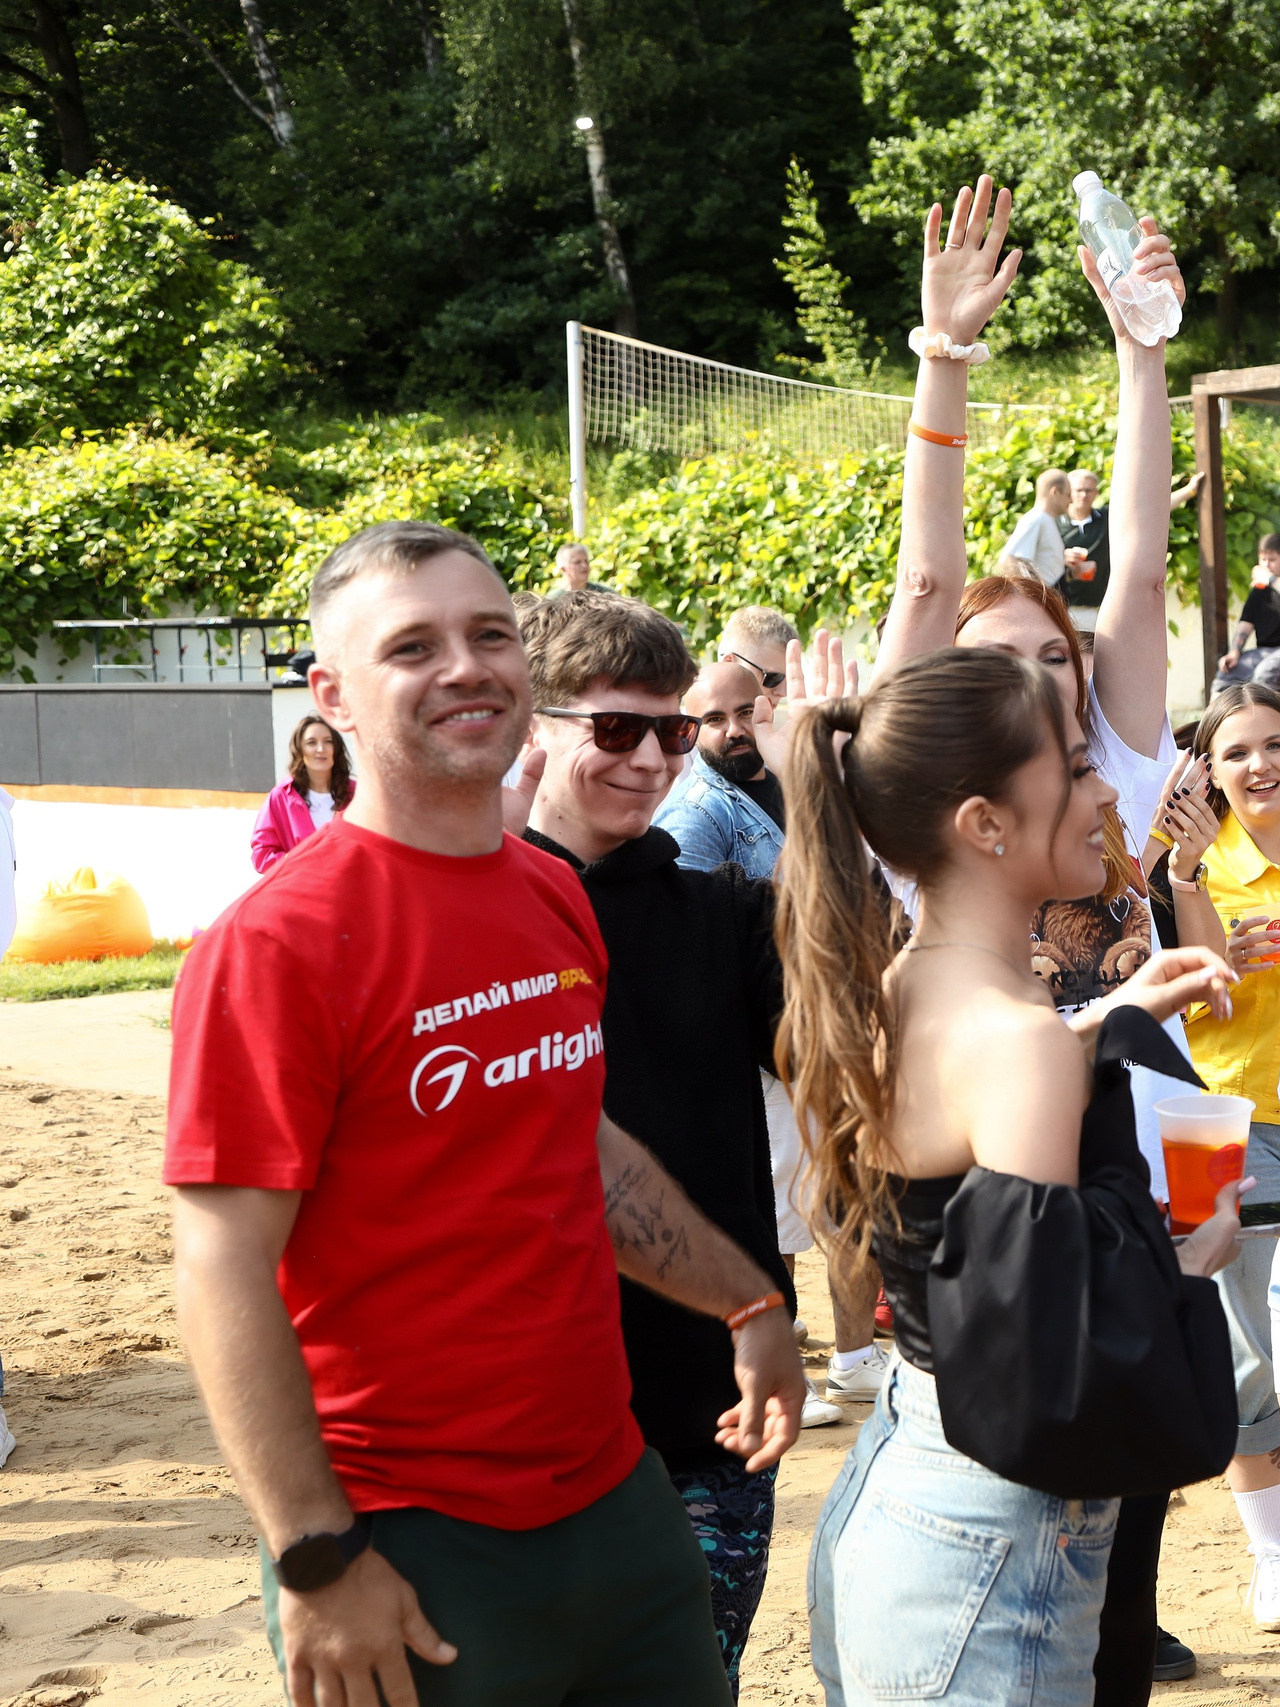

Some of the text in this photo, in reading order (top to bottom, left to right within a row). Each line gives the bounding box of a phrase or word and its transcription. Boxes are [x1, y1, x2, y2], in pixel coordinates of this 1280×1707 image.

[412, 967, 593, 1037] ДЕЛАЙ МИР ЯРЧ
